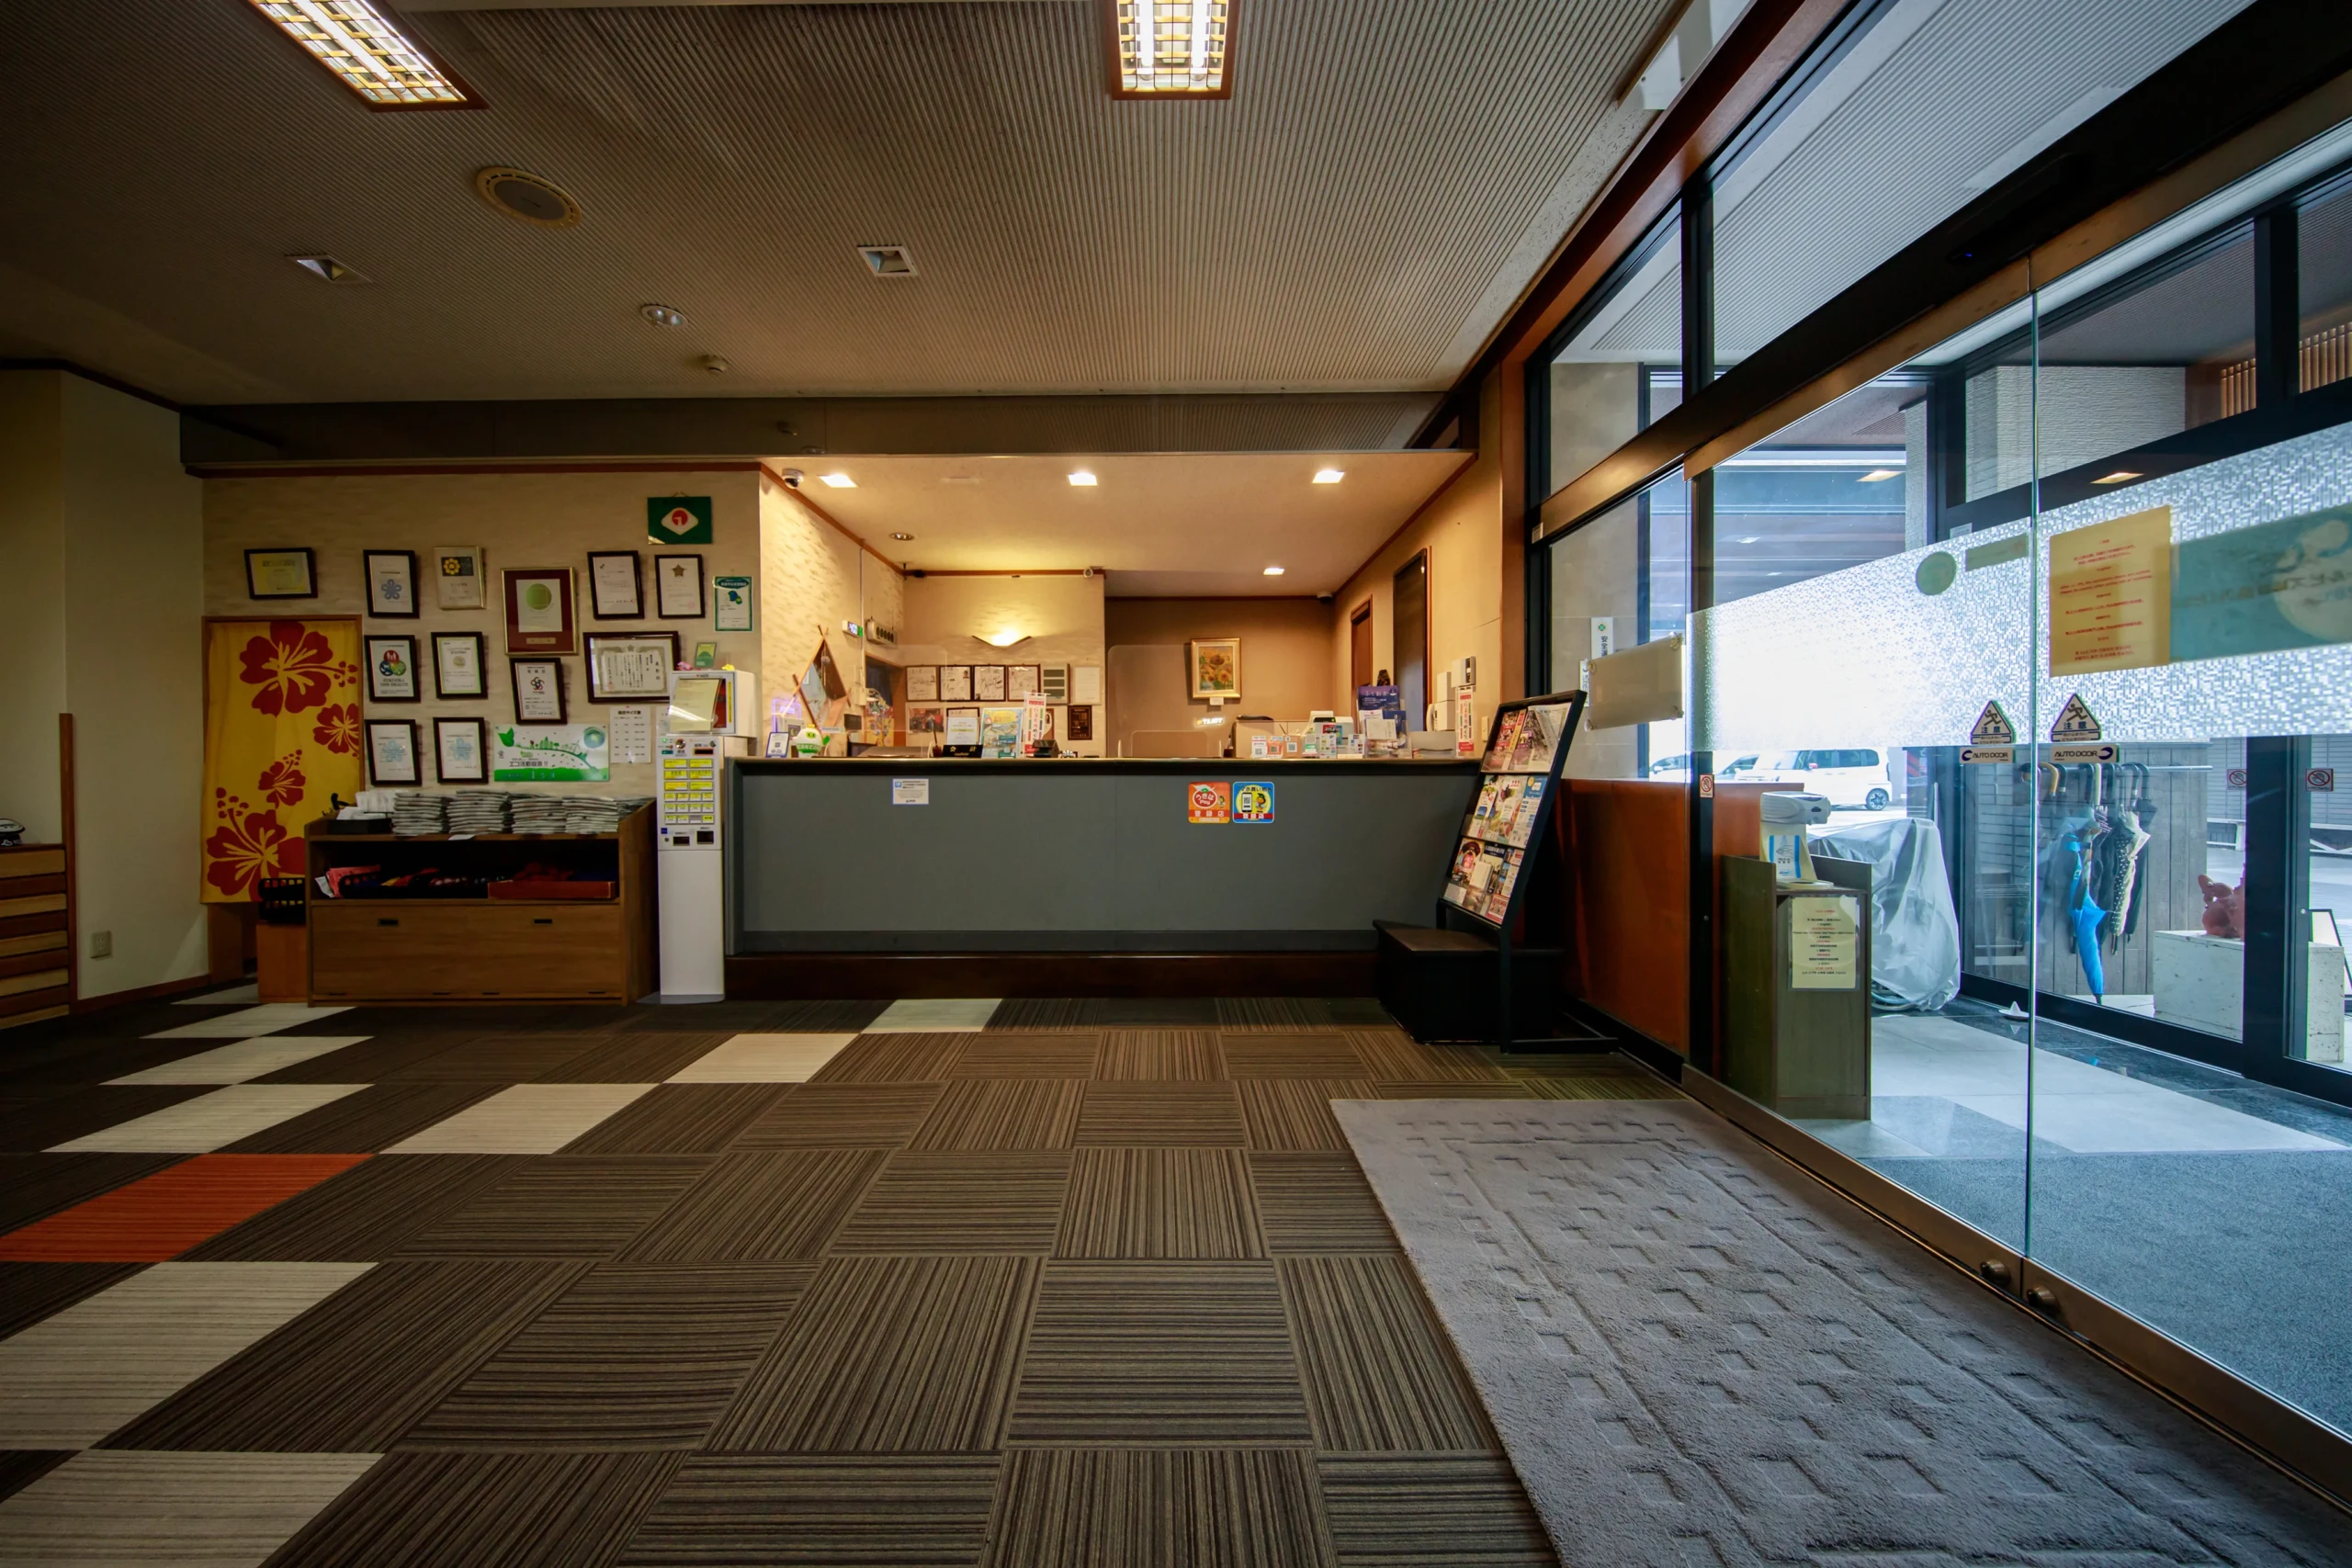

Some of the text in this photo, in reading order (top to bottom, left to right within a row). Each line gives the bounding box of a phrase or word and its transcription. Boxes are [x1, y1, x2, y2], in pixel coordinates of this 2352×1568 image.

[1981, 726, 2001, 734] 注意
[2064, 722, 2087, 730] 注意
[2075, 750, 2098, 758] DOOR
[1195, 793, 1215, 801] うきは
